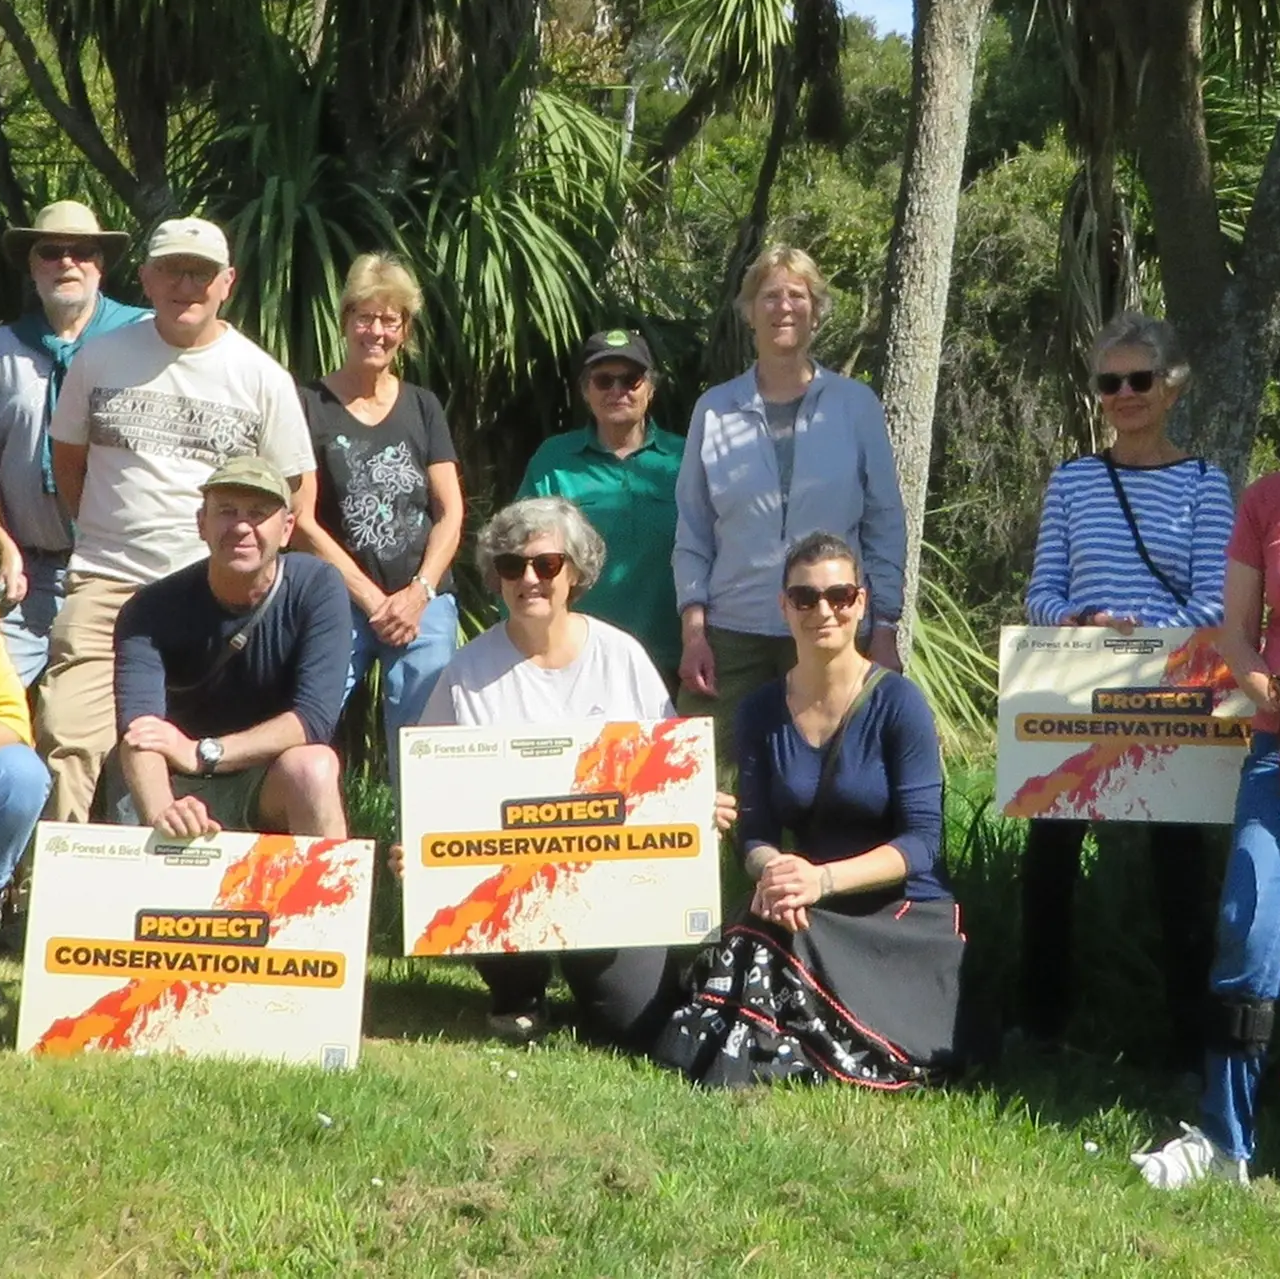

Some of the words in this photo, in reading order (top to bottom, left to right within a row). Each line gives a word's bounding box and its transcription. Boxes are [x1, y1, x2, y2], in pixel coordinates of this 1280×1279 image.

[1031, 640, 1061, 649] Forest
[1072, 640, 1092, 649] Bird
[1096, 693, 1207, 710] PROTECT
[1023, 719, 1207, 738] CONSERVATION
[434, 743, 466, 753] Forest
[468, 743, 475, 752] &
[477, 742, 498, 752] Bird
[506, 798, 621, 824] PROTECT
[71, 841, 106, 855] Forest
[109, 844, 117, 855] &
[118, 843, 141, 857] Bird
[431, 834, 620, 858] CONSERVATION
[627, 831, 693, 850] LAND
[139, 914, 264, 939] PROTECT
[54, 945, 260, 975] CONSERVATION
[266, 956, 339, 979] LAND
